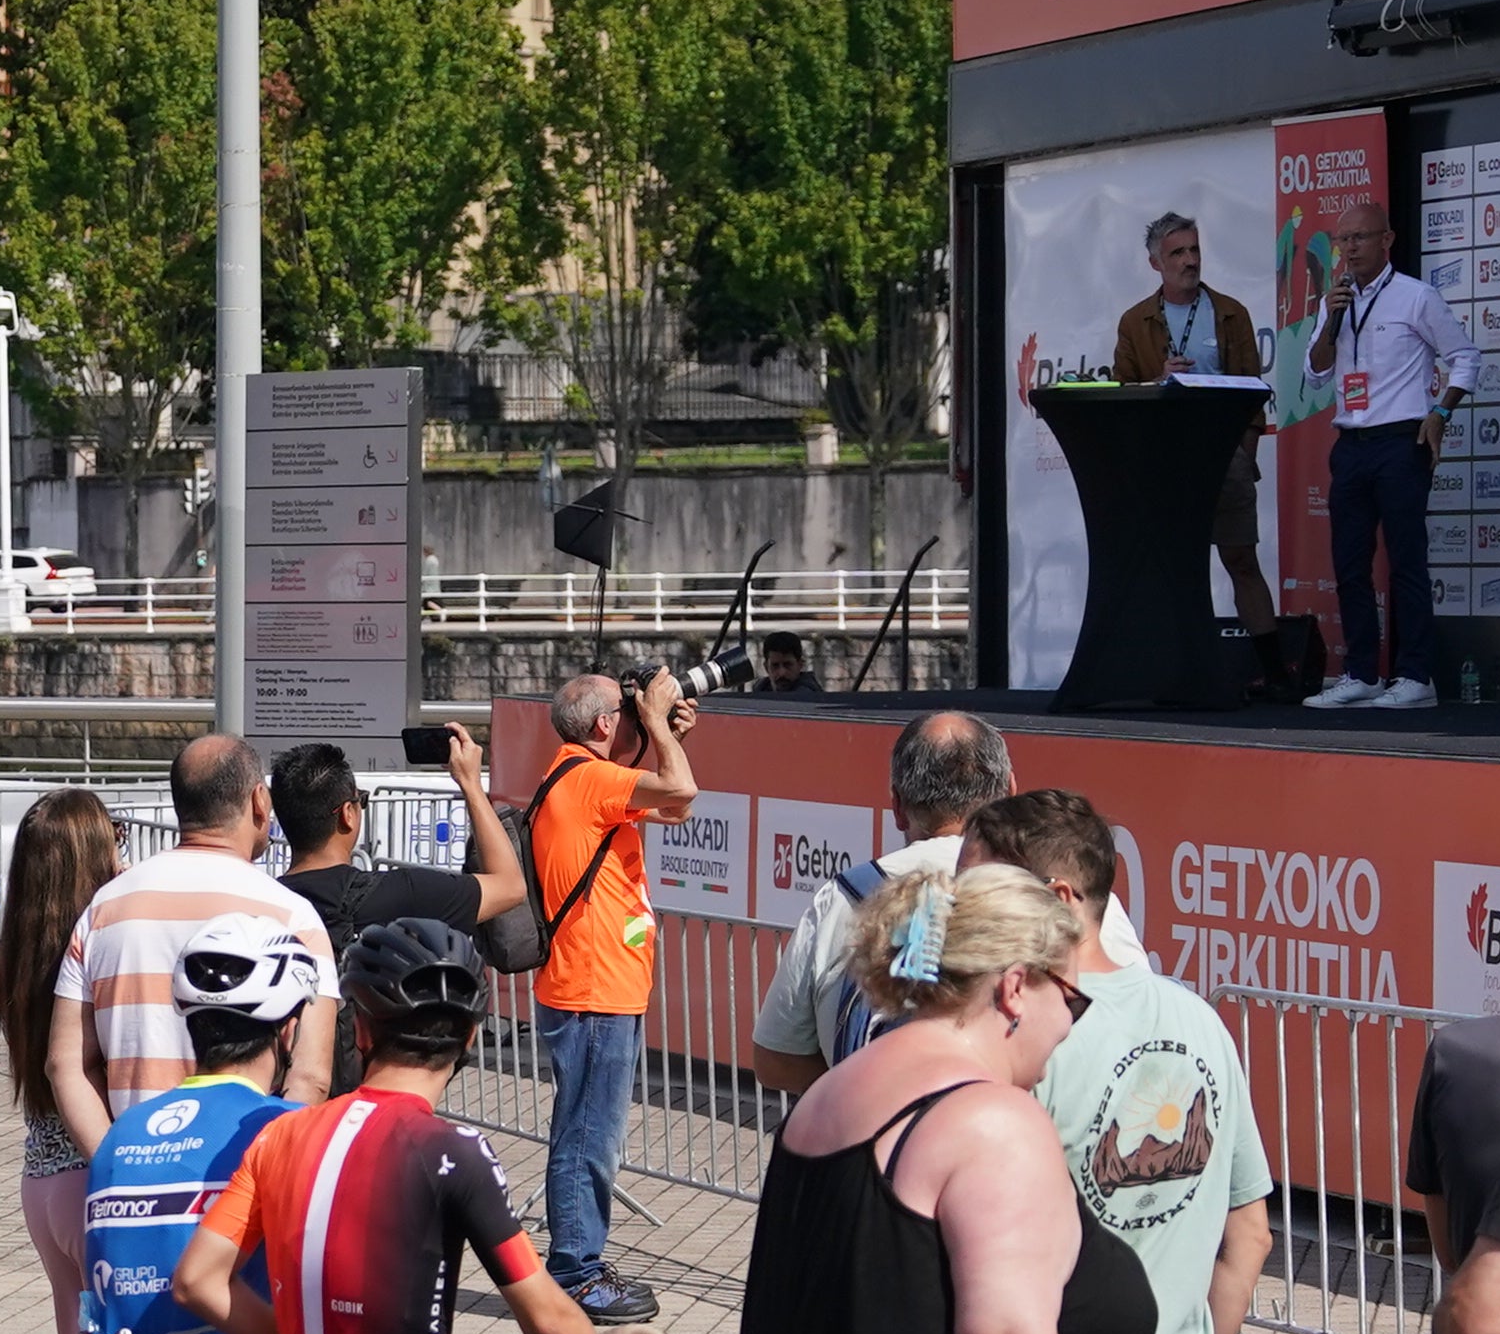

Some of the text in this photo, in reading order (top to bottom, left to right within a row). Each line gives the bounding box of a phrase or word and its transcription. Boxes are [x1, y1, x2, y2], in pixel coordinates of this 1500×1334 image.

[1316, 149, 1366, 170] GETXOKO
[1280, 155, 1313, 194] 80.
[1316, 169, 1371, 189] ZIRKUITUA
[256, 688, 307, 698] 10:00 19:00
[795, 834, 851, 878] Getxo
[661, 855, 728, 879] BASQUE COUNTRY
[1172, 841, 1380, 936] GETXOKO
[1171, 924, 1403, 1028] ZIRKUITUA
[1114, 1039, 1188, 1080] DICKIES
[114, 1137, 204, 1157] omarfraile
[124, 1153, 182, 1165] eskola
[90, 1199, 158, 1218] Petronor
[114, 1265, 157, 1281] GRUPO
[115, 1277, 174, 1296] DROMED
[331, 1299, 364, 1315] GOBIK
